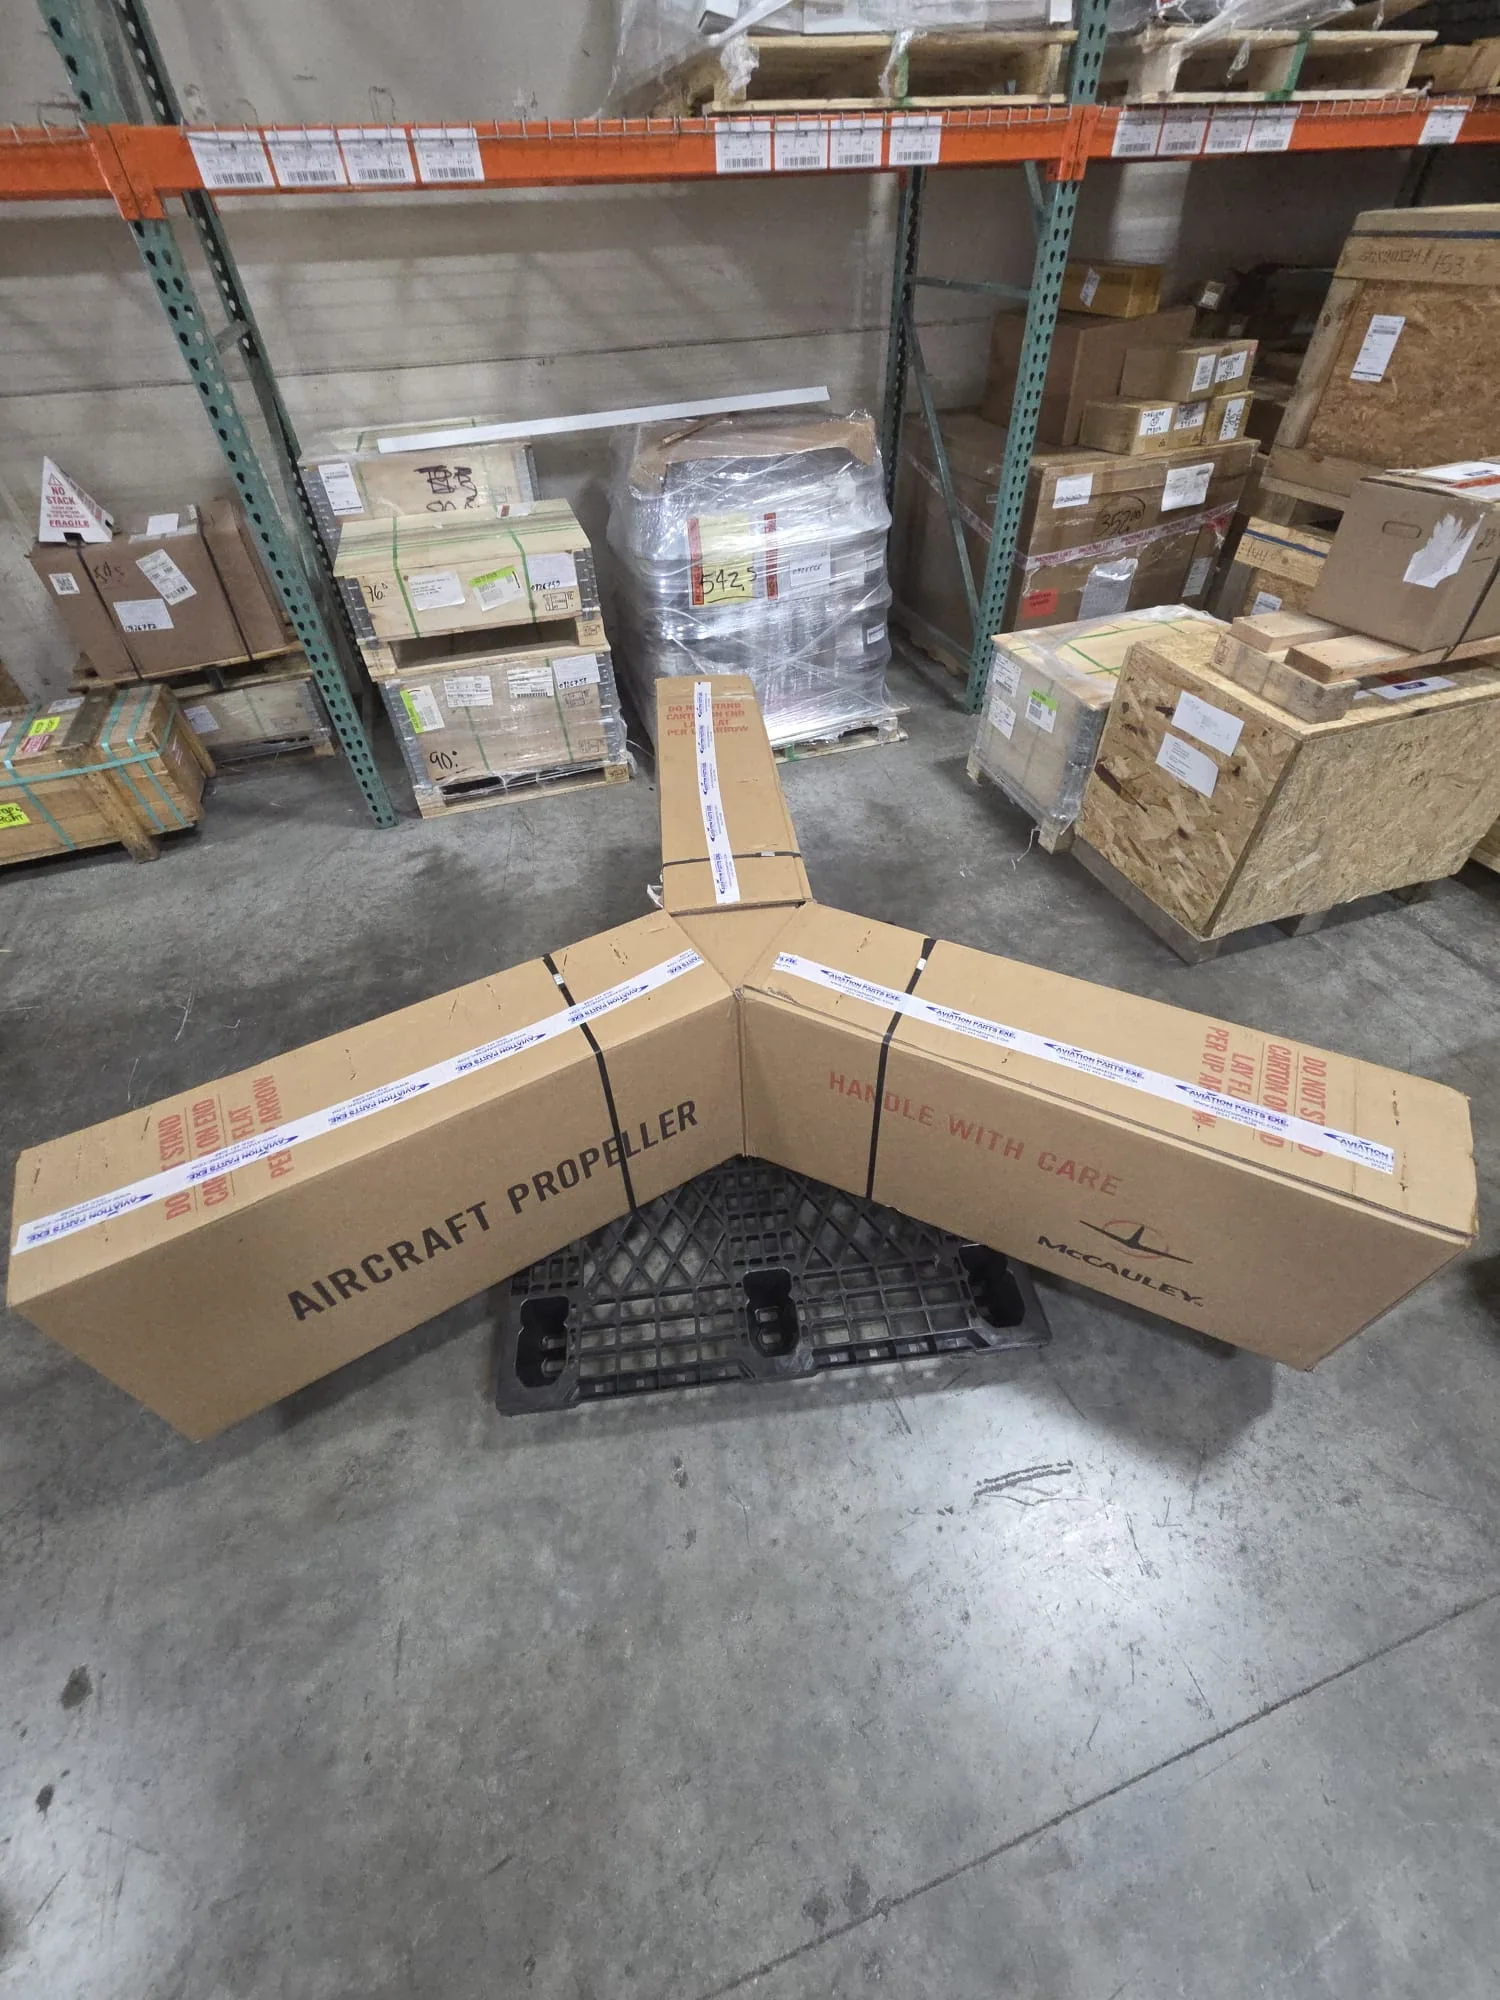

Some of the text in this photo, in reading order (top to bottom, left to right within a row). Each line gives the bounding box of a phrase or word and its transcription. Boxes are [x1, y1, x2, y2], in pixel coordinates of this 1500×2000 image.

[46, 496, 76, 505] STACK
[50, 486, 65, 496] NO
[49, 519, 89, 528] FRAGILE
[828, 973, 862, 987] AVIATION
[862, 984, 885, 996] PARTS
[567, 986, 639, 1024] AVIATION PARTS EXE.
[936, 1009, 1016, 1038] AVIATION PARTS EXE.
[454, 1035, 534, 1072] AVIATION PARTS EXE.
[1205, 1026, 1229, 1052] PER
[1055, 1046, 1145, 1079] AVIATION PARTS EXE.
[1202, 1053, 1226, 1073] UP
[1231, 1053, 1255, 1080] LAY
[1264, 1044, 1292, 1095] CARTON
[1302, 1056, 1327, 1077] DO
[253, 1075, 284, 1124] ARROW
[327, 1085, 416, 1124] AVIATION PARTS EXE.
[1188, 1089, 1289, 1127] AVIATION PARTS EXE.
[1300, 1077, 1327, 1109] NOT
[192, 1098, 218, 1127] END
[228, 1105, 256, 1141] FLAT
[158, 1114, 185, 1161] STAND
[195, 1124, 221, 1149] ON
[829, 1071, 1123, 1197] HANDLE WITH CARE
[1339, 1138, 1389, 1158] AVIATION
[185, 1138, 285, 1181] AVIATION PARTS EXE.
[87, 1196, 138, 1220] AVIATION
[287, 1100, 699, 1321] AIRCRAFT PROPELLER
[51, 1215, 87, 1233] PARTS
[1037, 1235, 1204, 1304] McCAULEY
